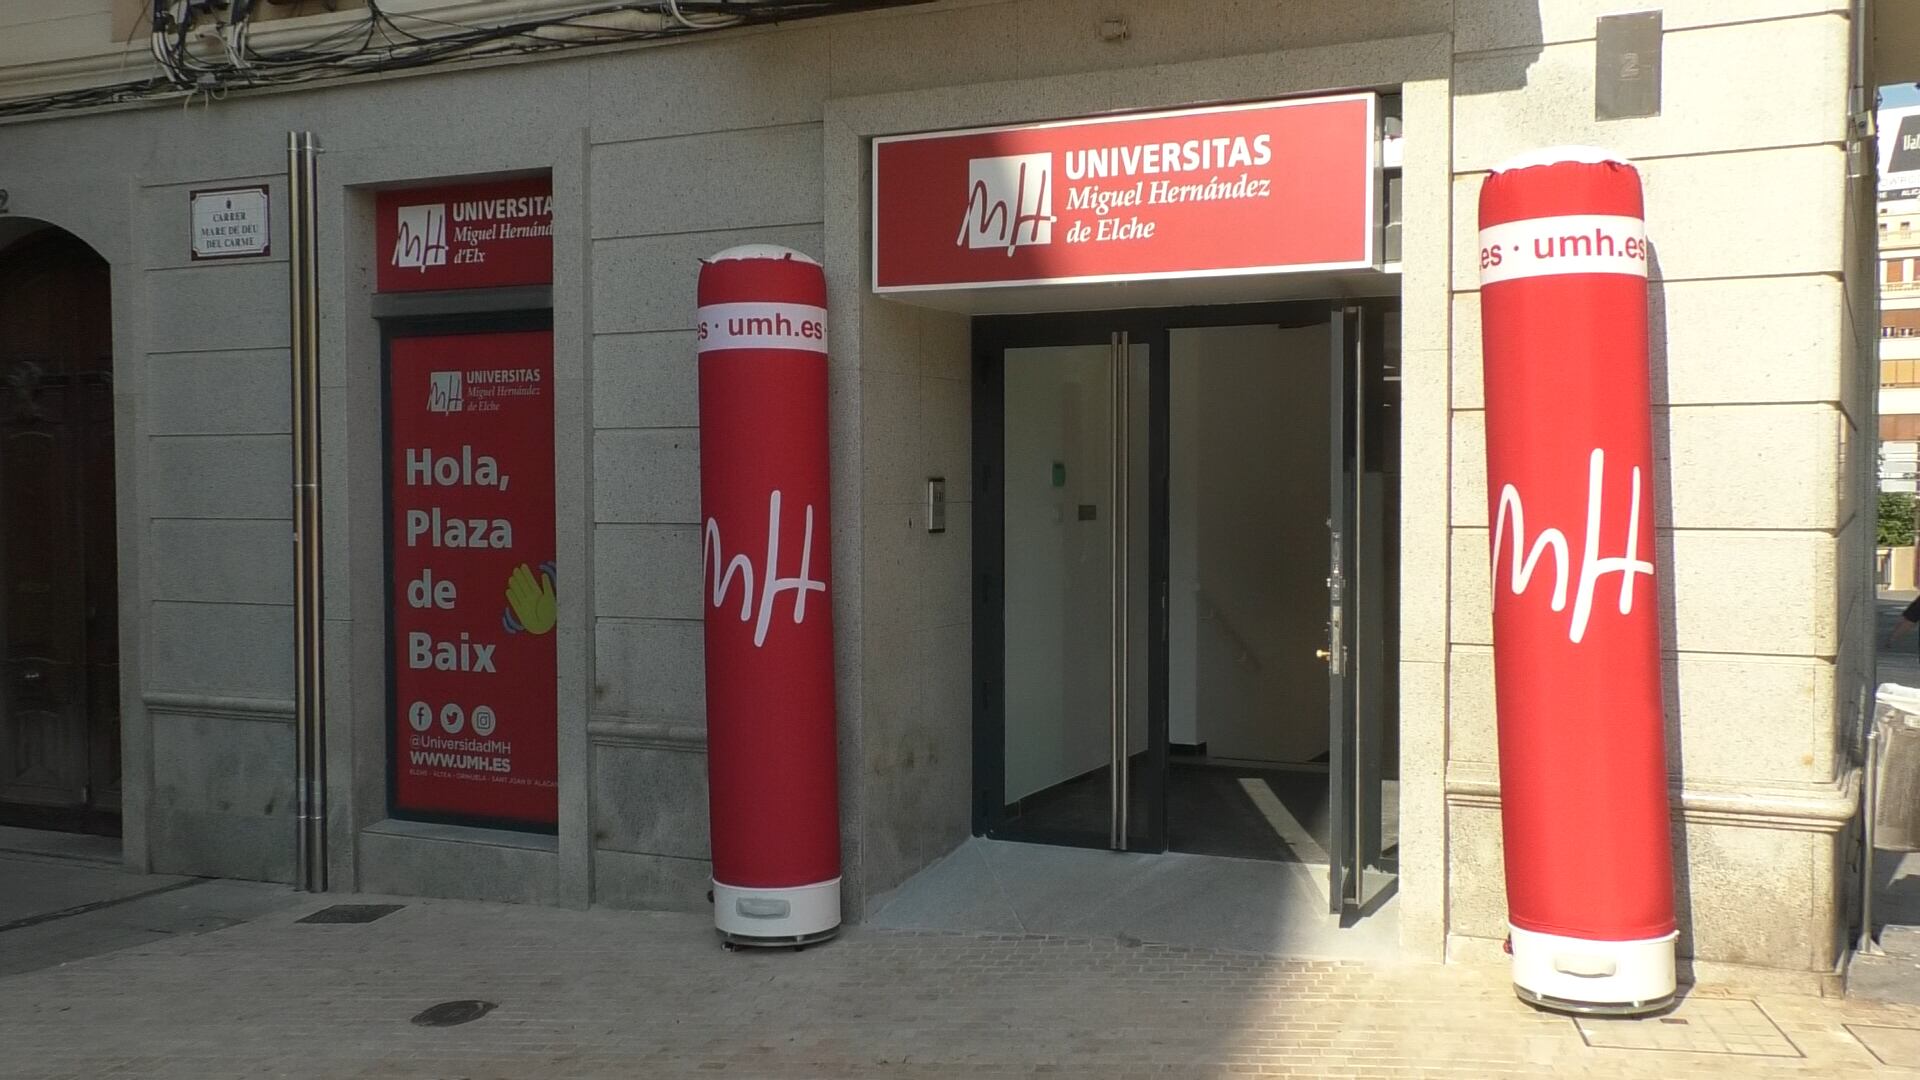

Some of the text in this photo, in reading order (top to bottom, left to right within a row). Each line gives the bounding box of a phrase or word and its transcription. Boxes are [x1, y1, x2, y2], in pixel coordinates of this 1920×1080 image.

[1065, 134, 1272, 180] UNIVERSITAS
[1065, 174, 1272, 216] Miguel Hernández
[212, 212, 246, 222] CARRER
[201, 226, 226, 236] MARE
[228, 226, 240, 235] DE
[454, 224, 497, 246] Miguel
[1066, 216, 1156, 243] de Elche
[206, 239, 223, 249] DEL
[1534, 228, 1645, 261] umh.es
[454, 248, 485, 264] d'Elx
[728, 313, 823, 340] umh.es
[466, 369, 541, 383] UNIVERSITAS
[467, 384, 541, 399] Miguel Hernández
[467, 401, 500, 411] de Elche
[406, 445, 510, 491] Hola,
[406, 507, 513, 548] Plaza
[407, 568, 457, 610] de
[408, 631, 497, 673] Baix
[411, 735, 511, 754] @UniversidadMH
[410, 751, 511, 773] WWW.UMH.ES
